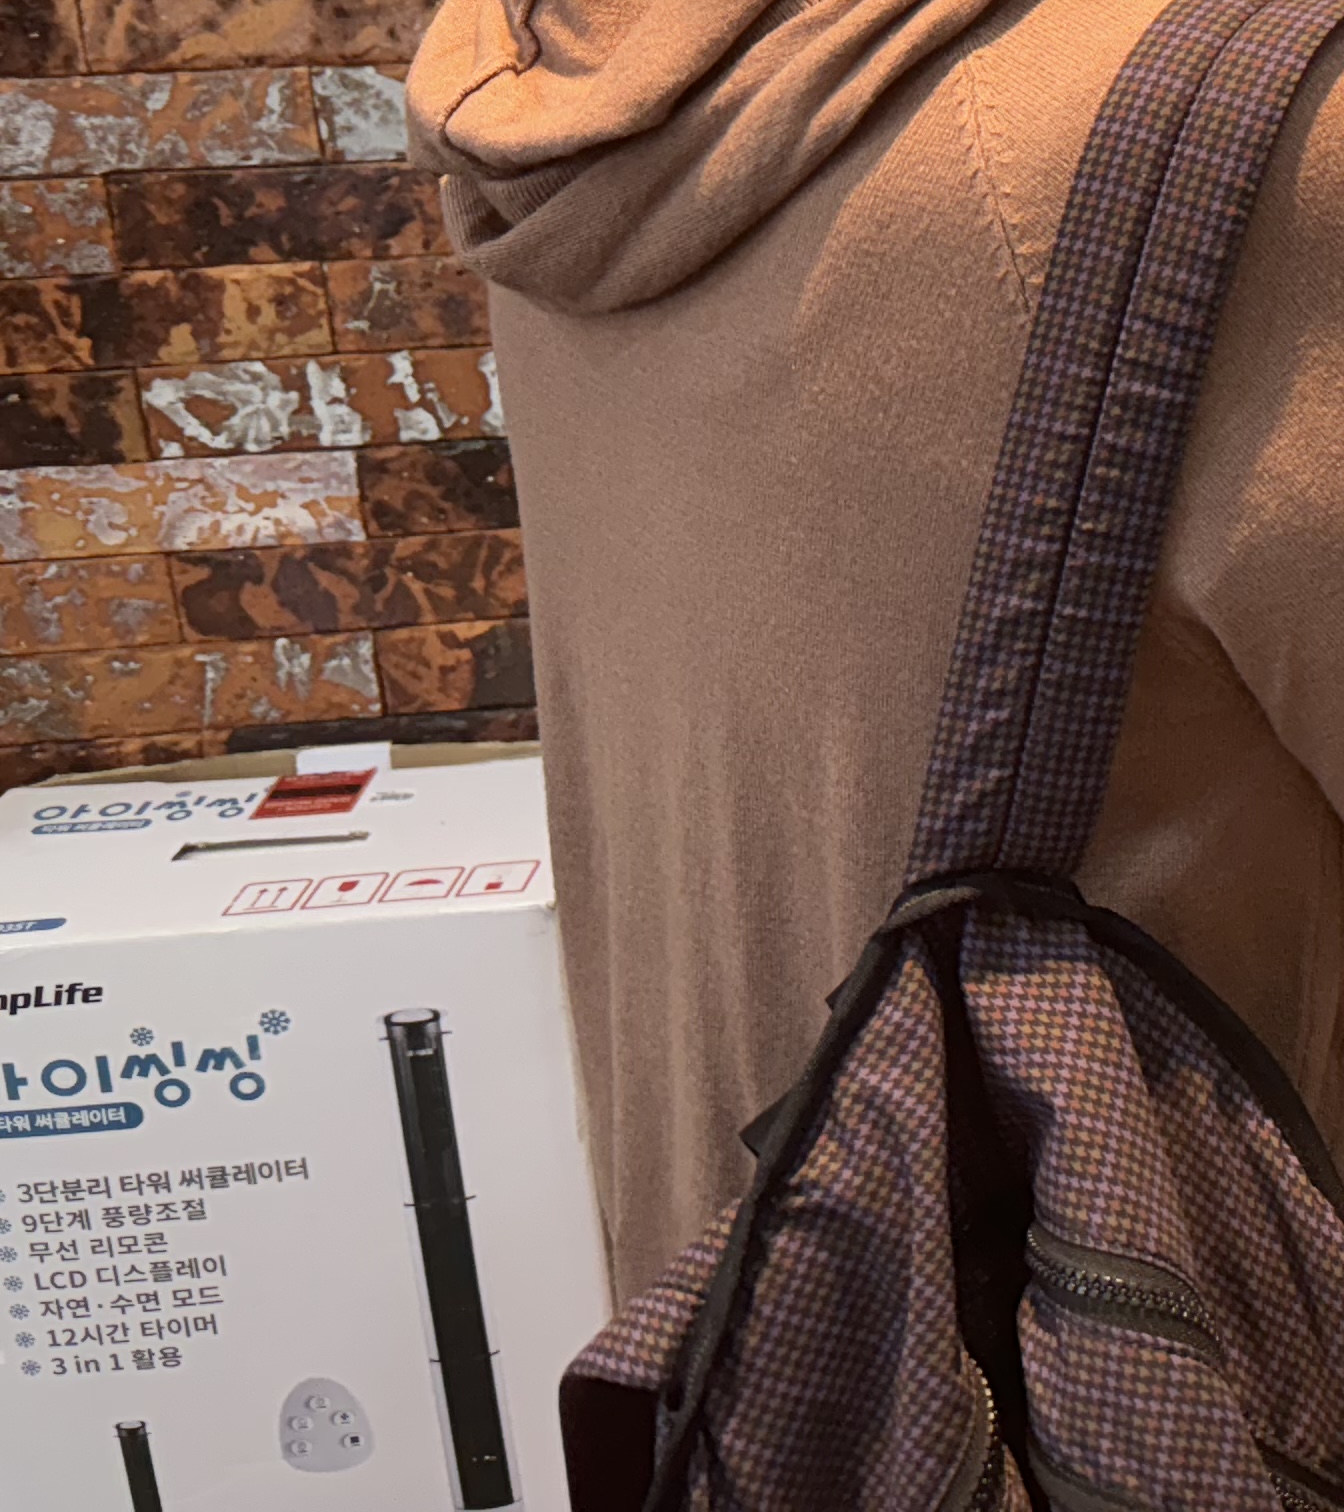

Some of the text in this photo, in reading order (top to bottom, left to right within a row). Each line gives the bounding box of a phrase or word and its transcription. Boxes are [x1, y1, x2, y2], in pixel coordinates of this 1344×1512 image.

[34, 1106, 127, 1129] 써큘레이터
[16, 1157, 311, 1204] 3단분리 타워 써큘레이터
[21, 1197, 209, 1235] 9단계 풍량조절
[28, 1231, 169, 1265] 무선 리모콘
[34, 1254, 228, 1291] LCD 디스플레이
[171, 1285, 225, 1308] 모드
[47, 1313, 220, 1348] 12시간 타이머
[50, 1346, 183, 1376] 3 in 1 활용
